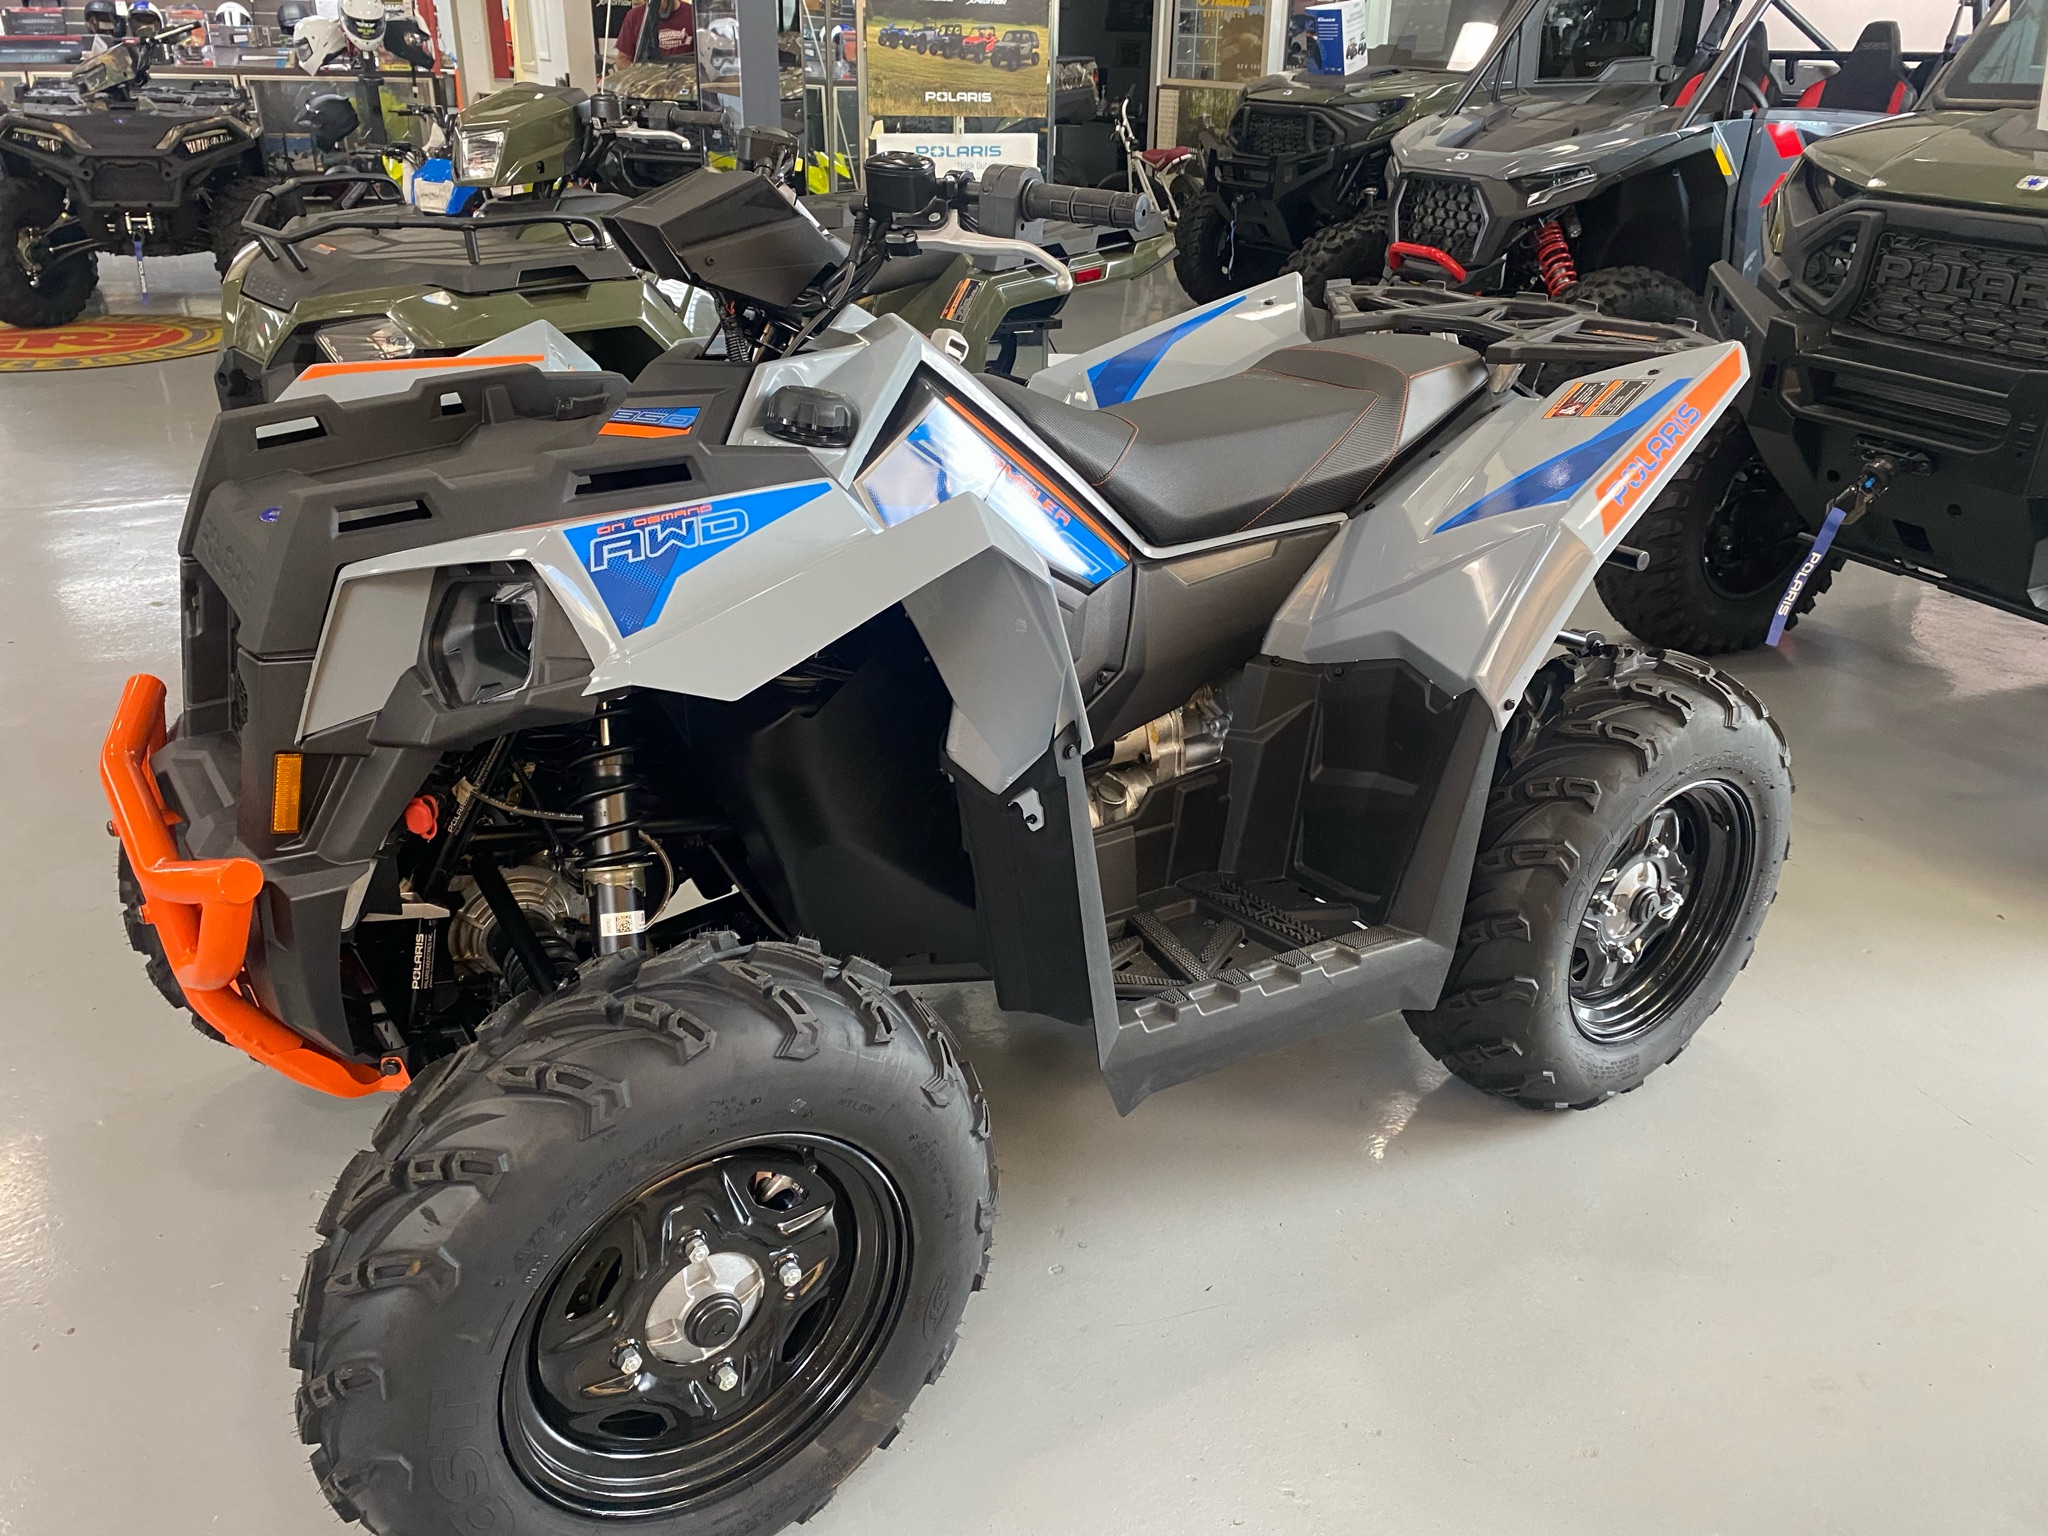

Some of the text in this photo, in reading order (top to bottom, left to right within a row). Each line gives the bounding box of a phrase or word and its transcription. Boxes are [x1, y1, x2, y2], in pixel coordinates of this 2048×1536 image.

[924, 91, 992, 103] POLARIS
[915, 145, 1002, 157] POLARIS
[1876, 254, 2048, 309] POLAR
[1606, 402, 1701, 507] POLARIS
[590, 508, 749, 573] AWD
[633, 503, 713, 527] DEMAND
[1778, 552, 1821, 616] POLARIS
[411, 933, 425, 990] POLARIS
